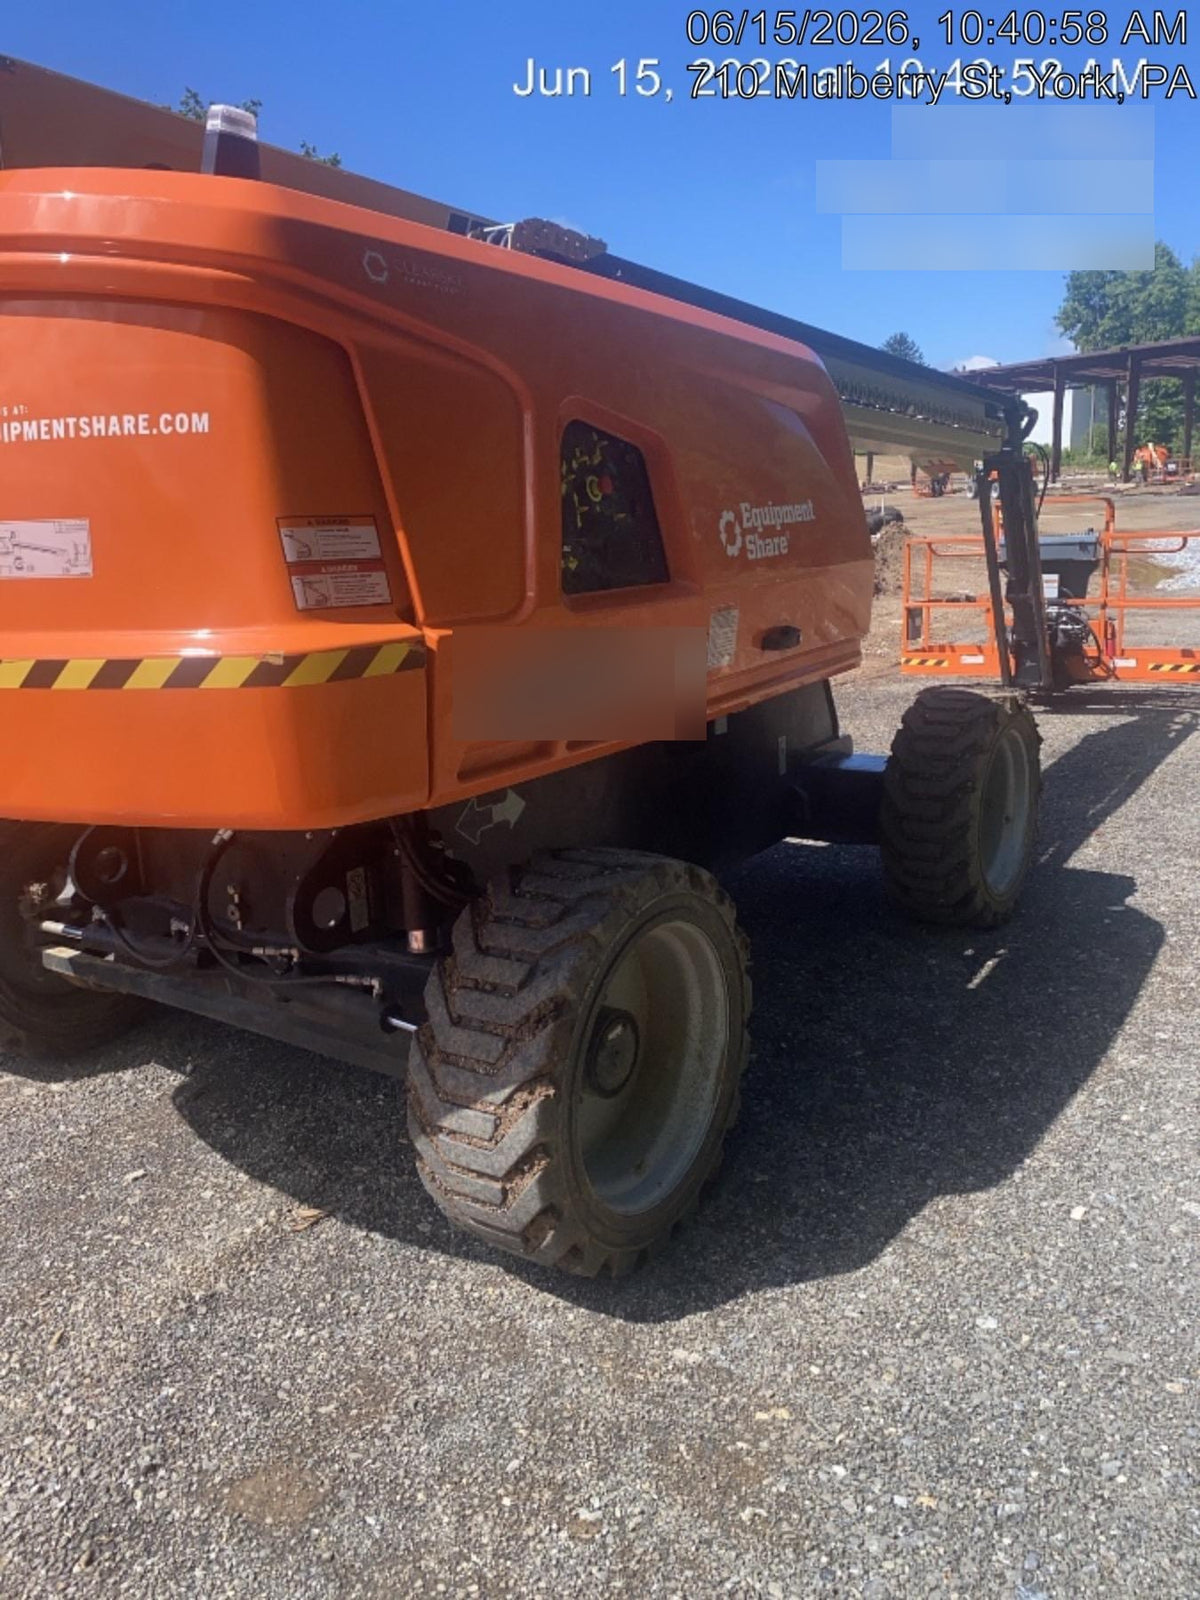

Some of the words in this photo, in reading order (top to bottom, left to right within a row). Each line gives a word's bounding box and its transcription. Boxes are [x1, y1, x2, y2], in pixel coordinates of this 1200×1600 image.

[12, 403, 29, 416] AT:
[0, 411, 209, 443] IPMENTSHARE.COM
[739, 499, 816, 532] Equipment
[744, 533, 790, 561] Share
